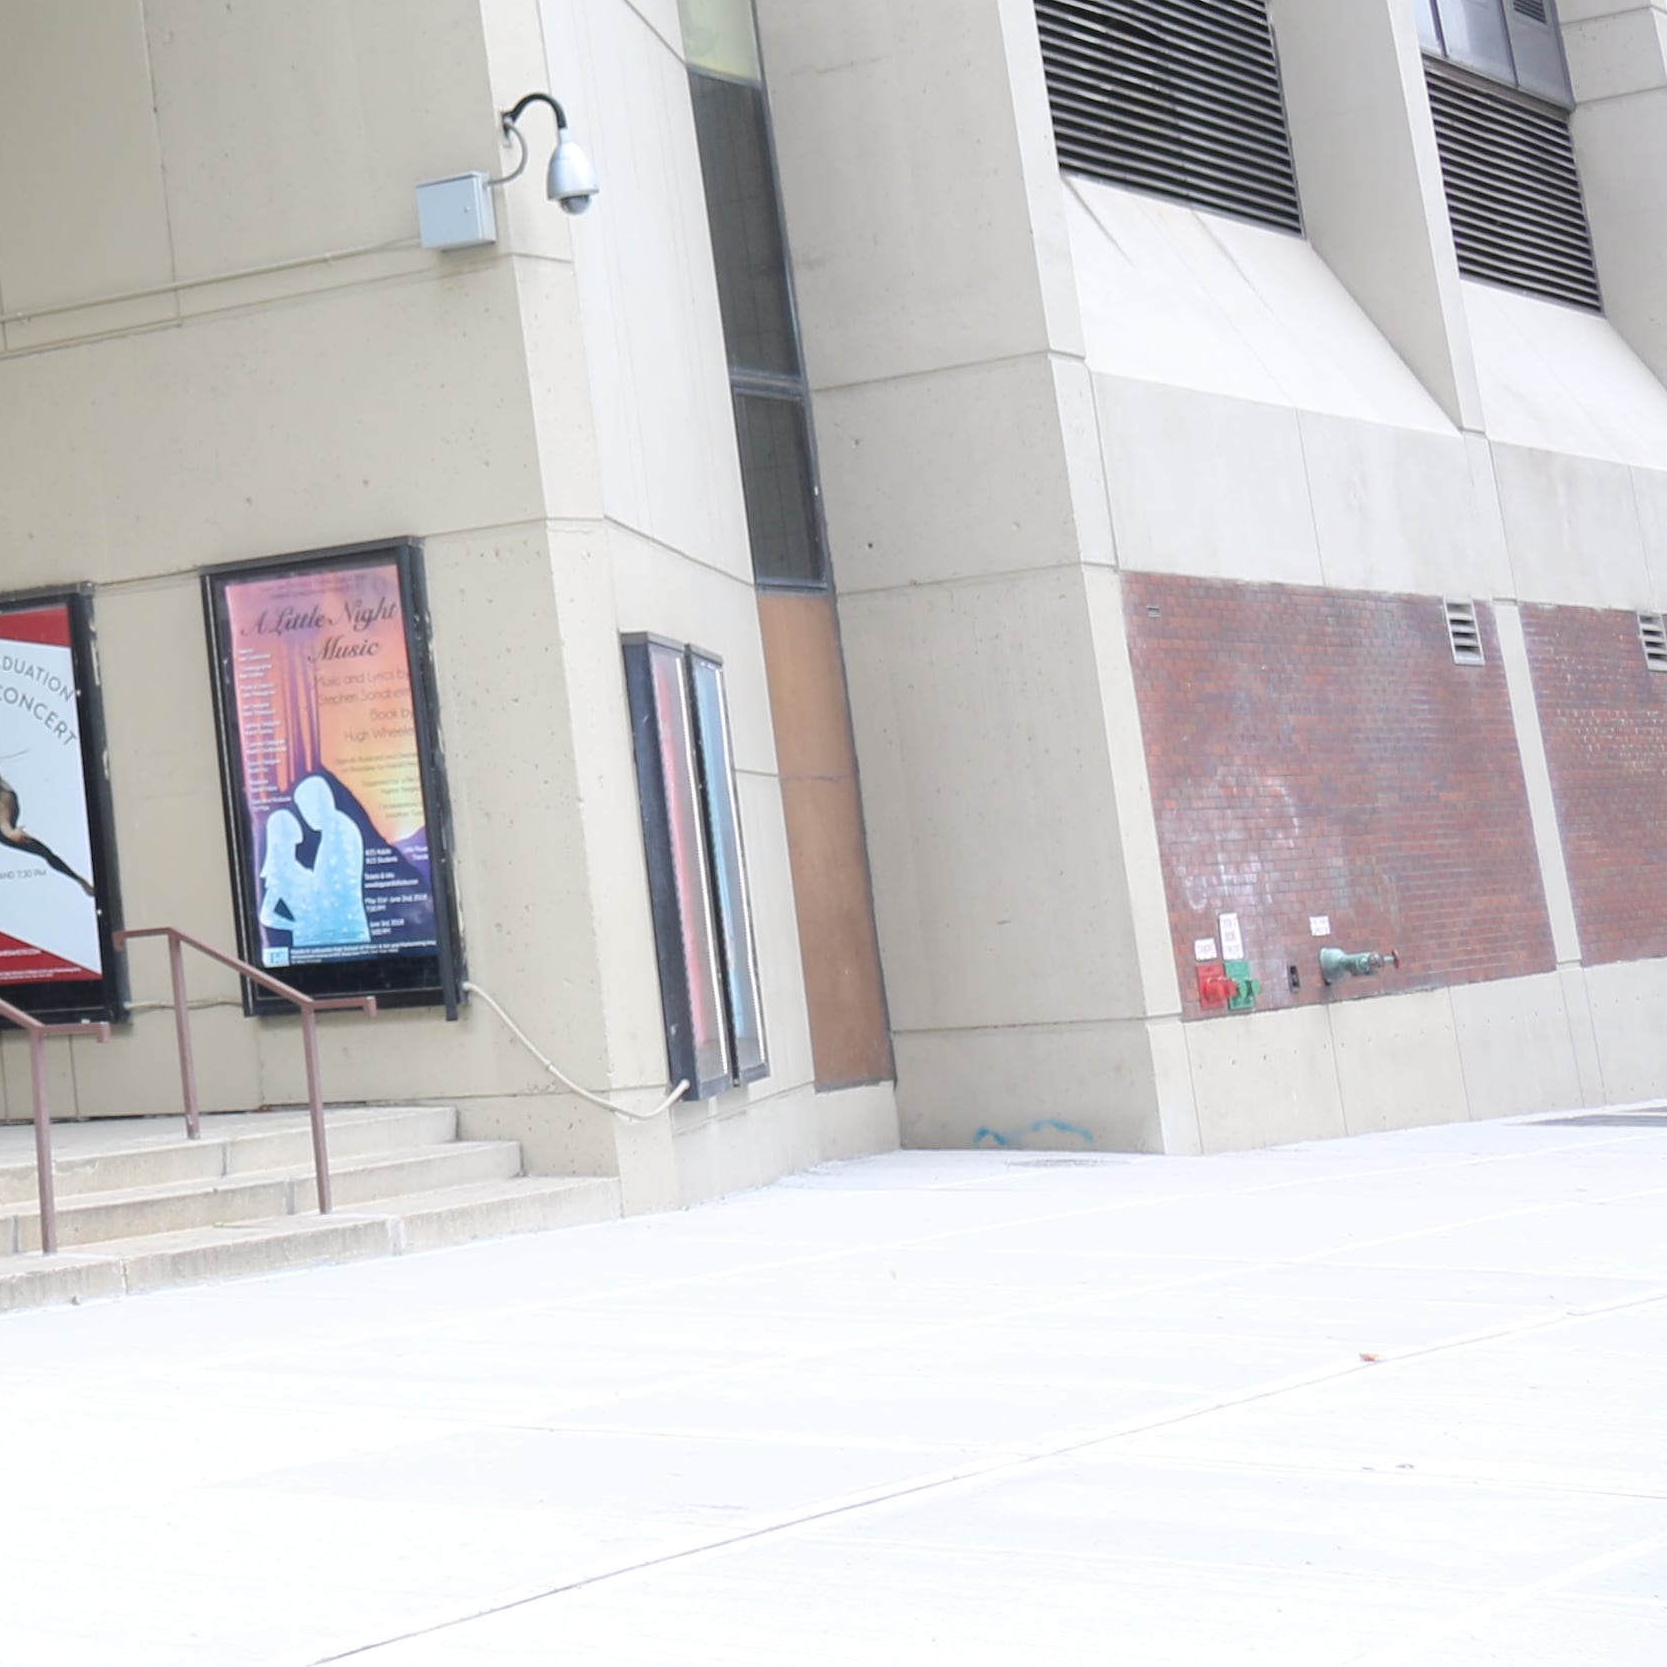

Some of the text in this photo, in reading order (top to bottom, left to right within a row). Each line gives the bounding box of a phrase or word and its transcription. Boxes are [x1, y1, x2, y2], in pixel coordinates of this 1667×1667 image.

[240, 596, 398, 636] A Little Night
[307, 634, 380, 664] Music
